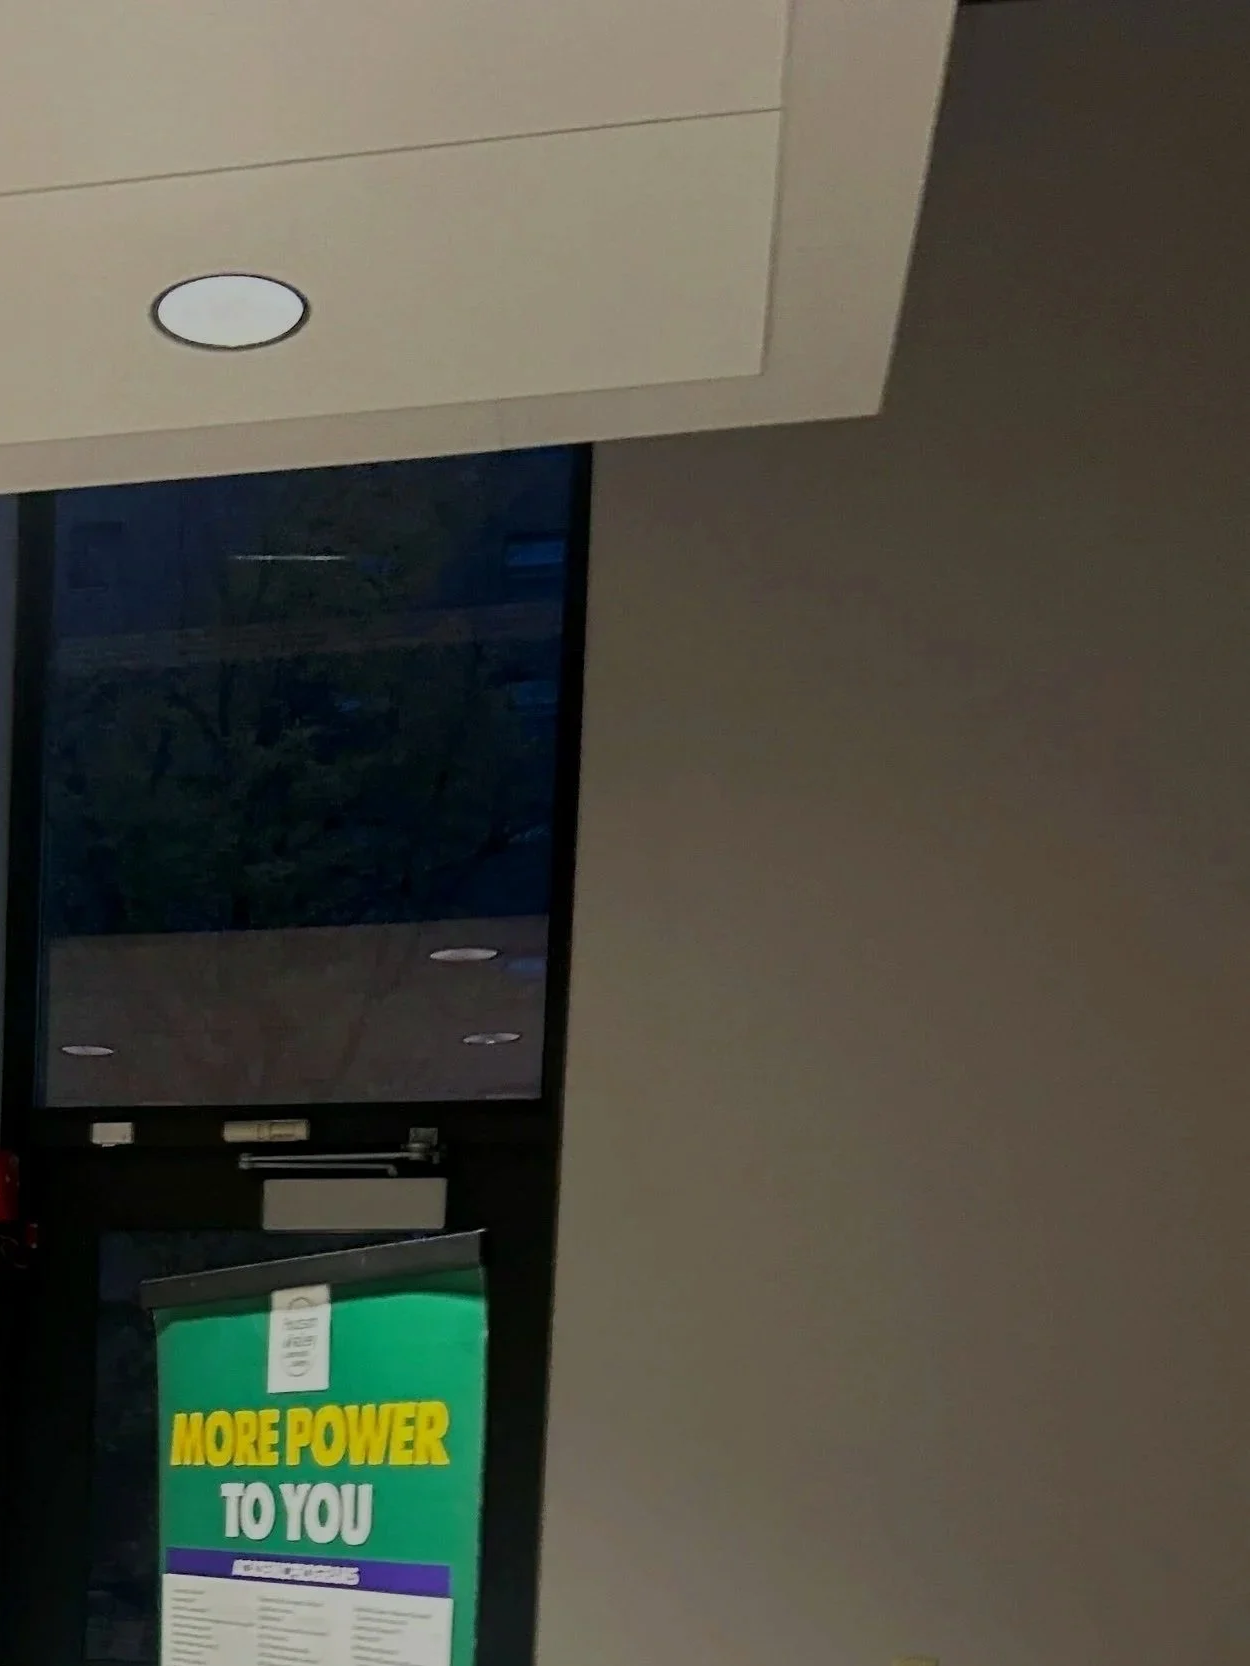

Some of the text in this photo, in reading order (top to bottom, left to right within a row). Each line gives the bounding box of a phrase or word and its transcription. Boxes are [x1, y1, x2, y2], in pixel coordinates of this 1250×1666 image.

[170, 1401, 450, 1468] MORE POWER
[221, 1482, 374, 1546] TO YOU
